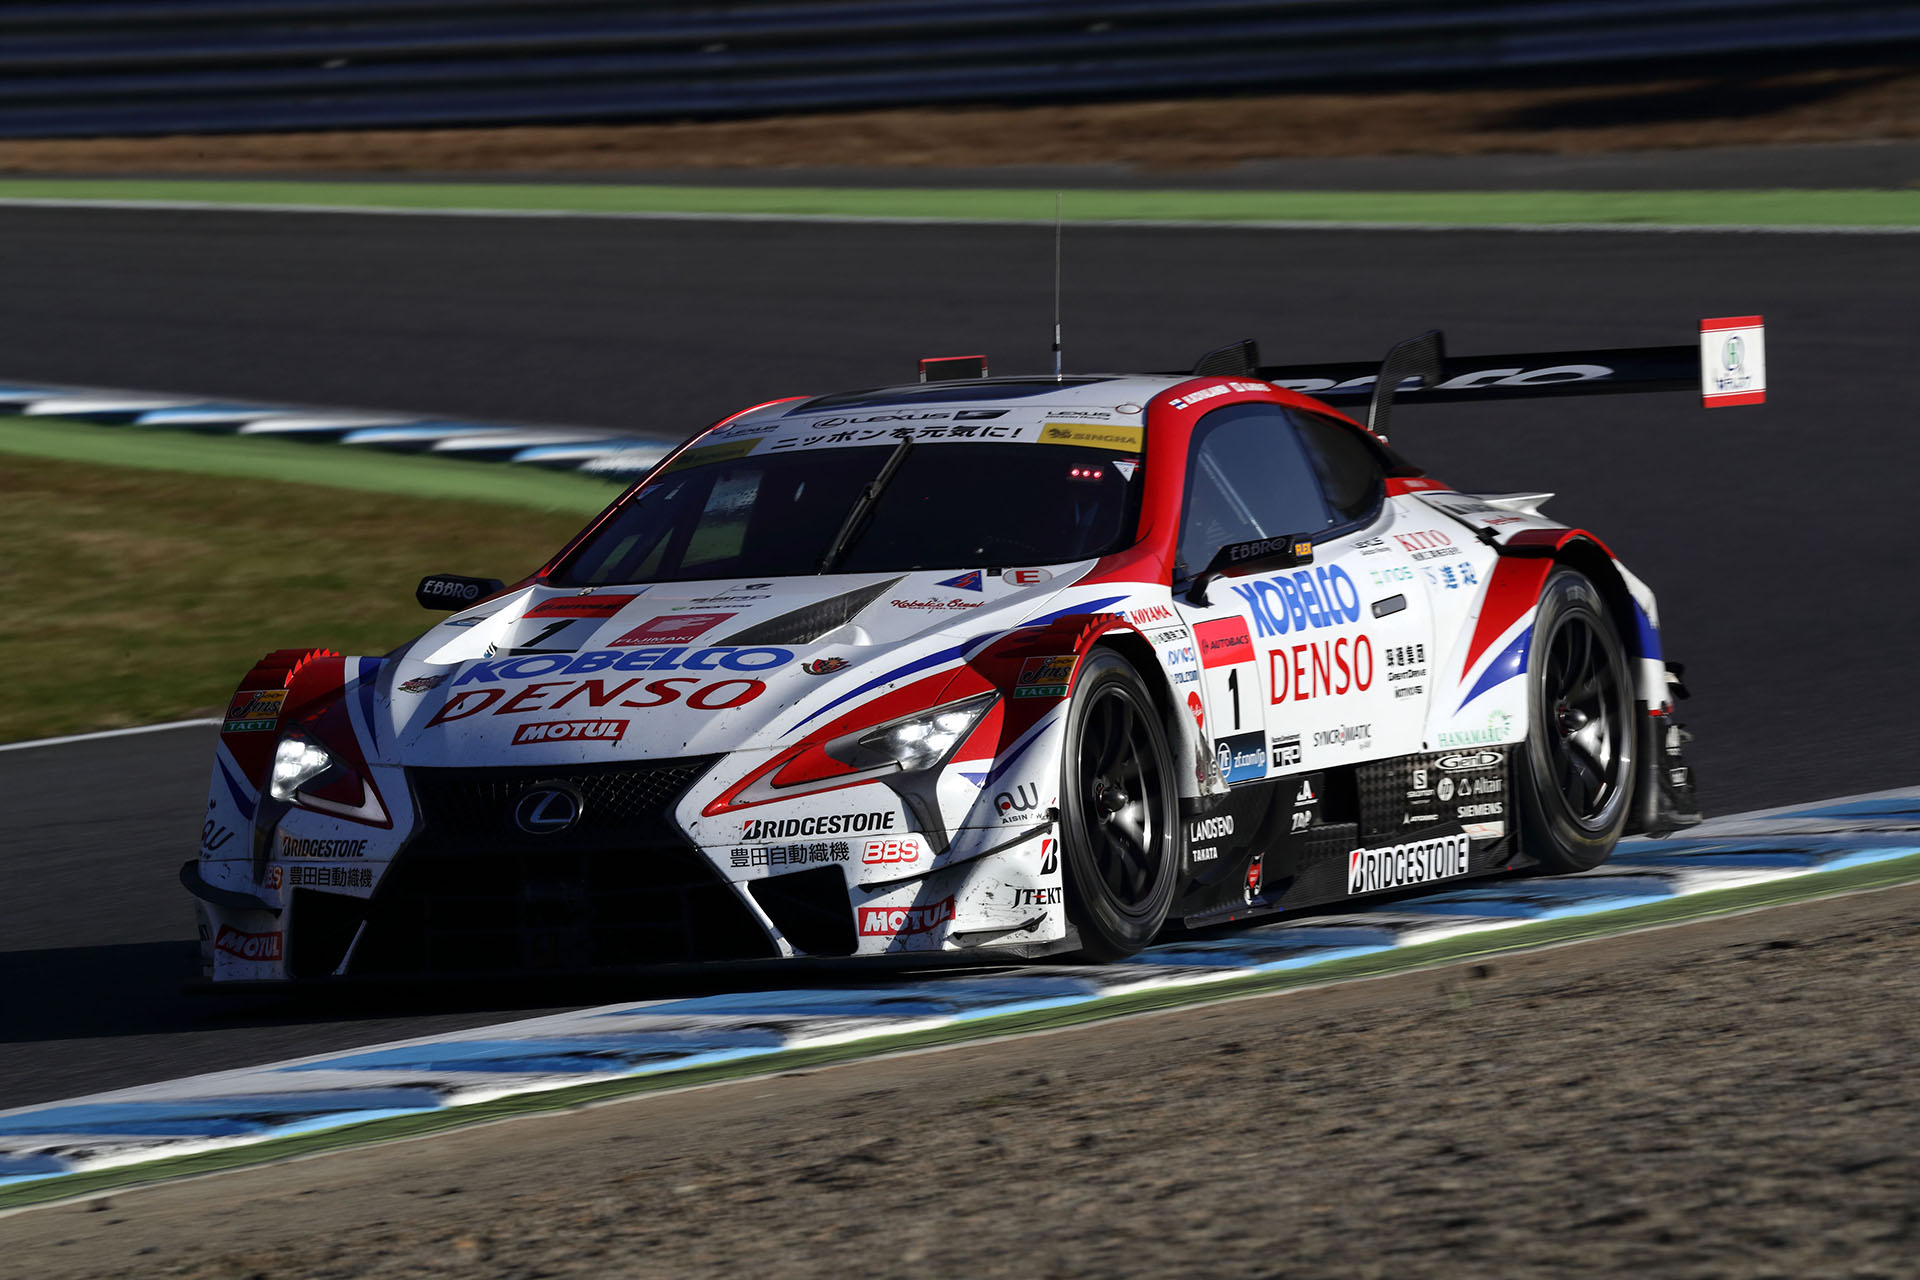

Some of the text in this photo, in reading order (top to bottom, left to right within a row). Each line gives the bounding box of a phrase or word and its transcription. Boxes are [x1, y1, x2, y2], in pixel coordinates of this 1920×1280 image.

[850, 413, 952, 423] LEXUS
[1072, 433, 1136, 445] SINGHA
[1231, 538, 1286, 560] EBBRO
[1394, 529, 1451, 551] KITO
[1015, 570, 1041, 583] E
[423, 580, 479, 600] EBBRO
[1231, 564, 1360, 637] KOBELCO
[1130, 605, 1173, 625] KOYAMA
[519, 619, 577, 648] 1
[616, 635, 694, 644] FUJIMAKI
[1210, 636, 1249, 649] AUTOBACS
[450, 647, 795, 687] KOBELCO
[1268, 634, 1373, 705] DENSO
[1020, 687, 1061, 696] TACTI
[1228, 668, 1240, 730] 1
[424, 678, 767, 728] DENSO
[229, 722, 270, 730] TACTI
[518, 721, 620, 741] MOTUL
[741, 811, 895, 840] BRIDGESTONE
[1002, 814, 1028, 824] AISIN
[282, 836, 368, 857] BRIDGESTONE
[730, 841, 850, 868] 豊田自動織機
[862, 839, 918, 864] BBS
[1192, 847, 1218, 862] TAKATA
[1351, 837, 1468, 893] BRIDGESTONE
[289, 866, 372, 888] 豊田自動織機
[1012, 887, 1061, 908] JTEKT
[864, 897, 954, 932] MOTUL
[217, 929, 279, 957] MOTUL
